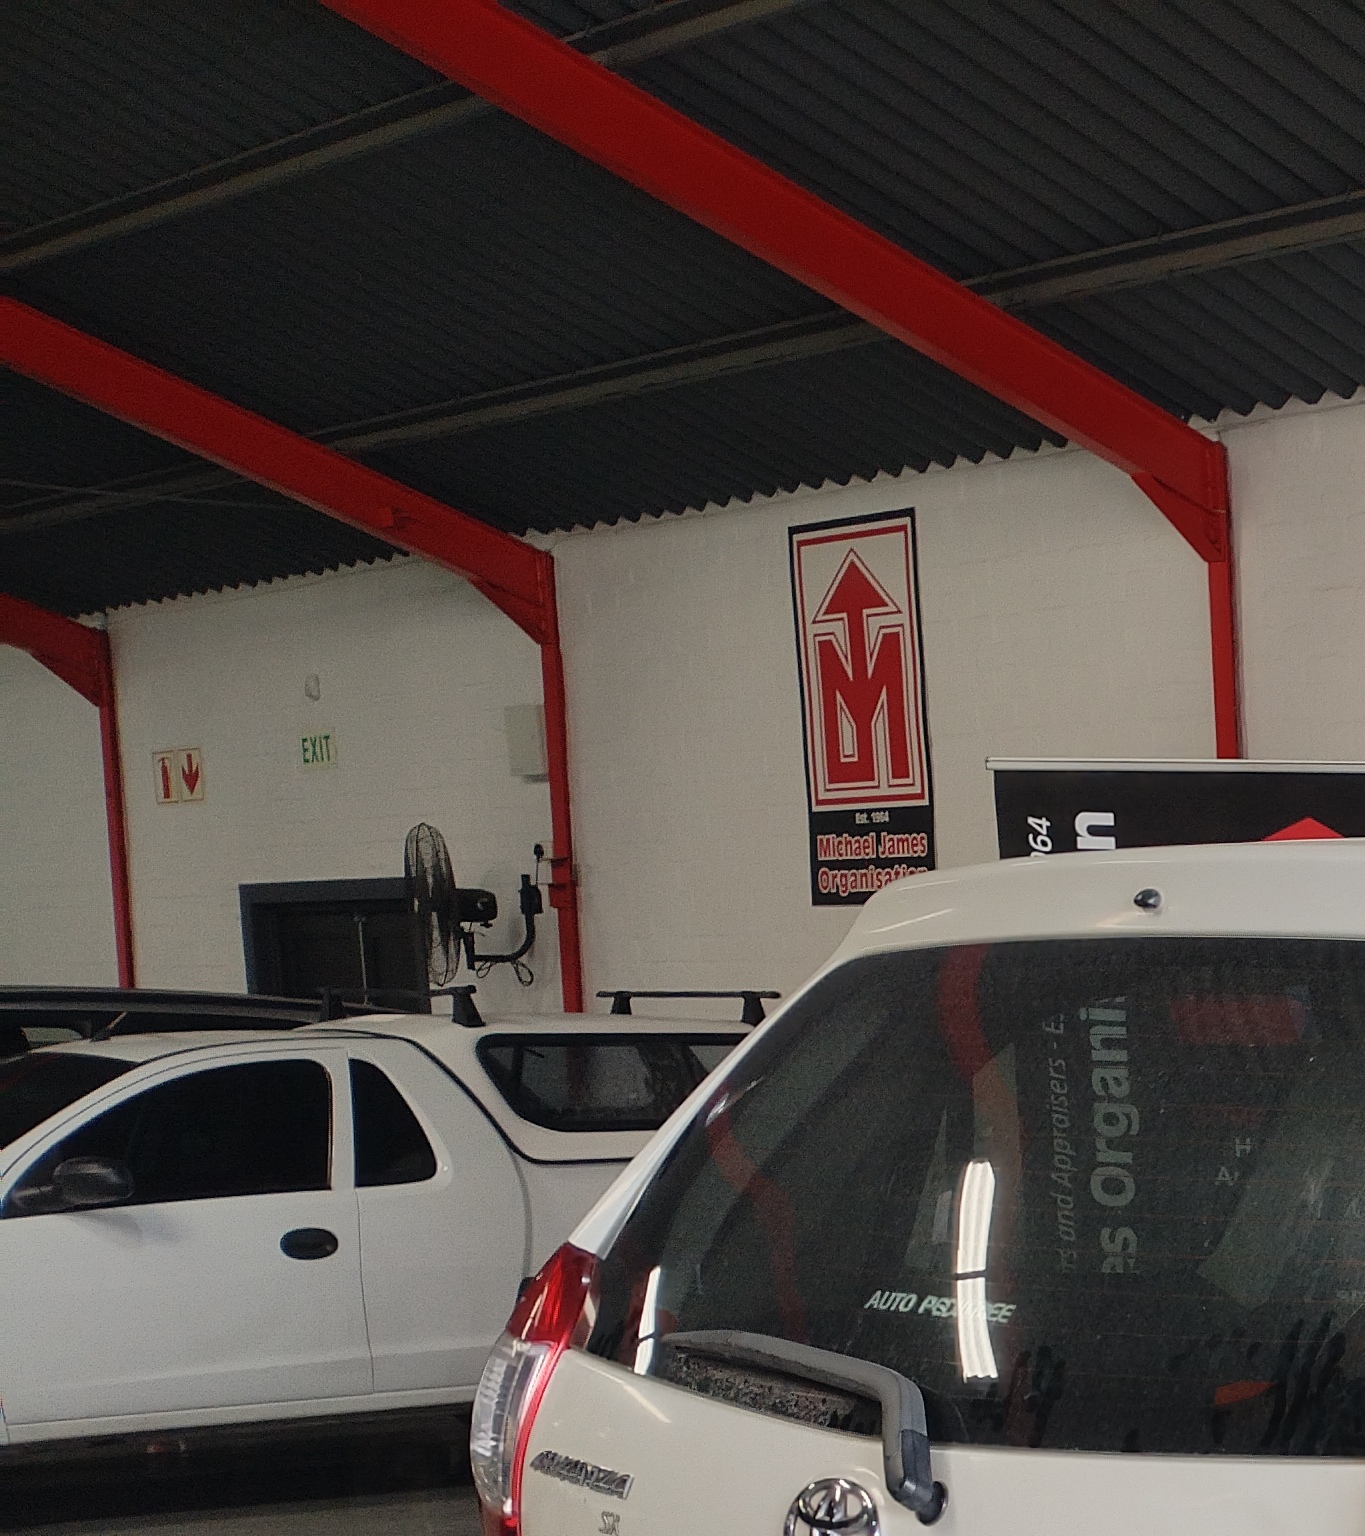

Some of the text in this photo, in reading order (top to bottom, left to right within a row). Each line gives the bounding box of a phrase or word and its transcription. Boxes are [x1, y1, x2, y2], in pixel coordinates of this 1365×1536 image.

[301, 734, 331, 764] EXIT
[817, 831, 928, 861] Michael James
[864, 1289, 919, 1313] AUTO
